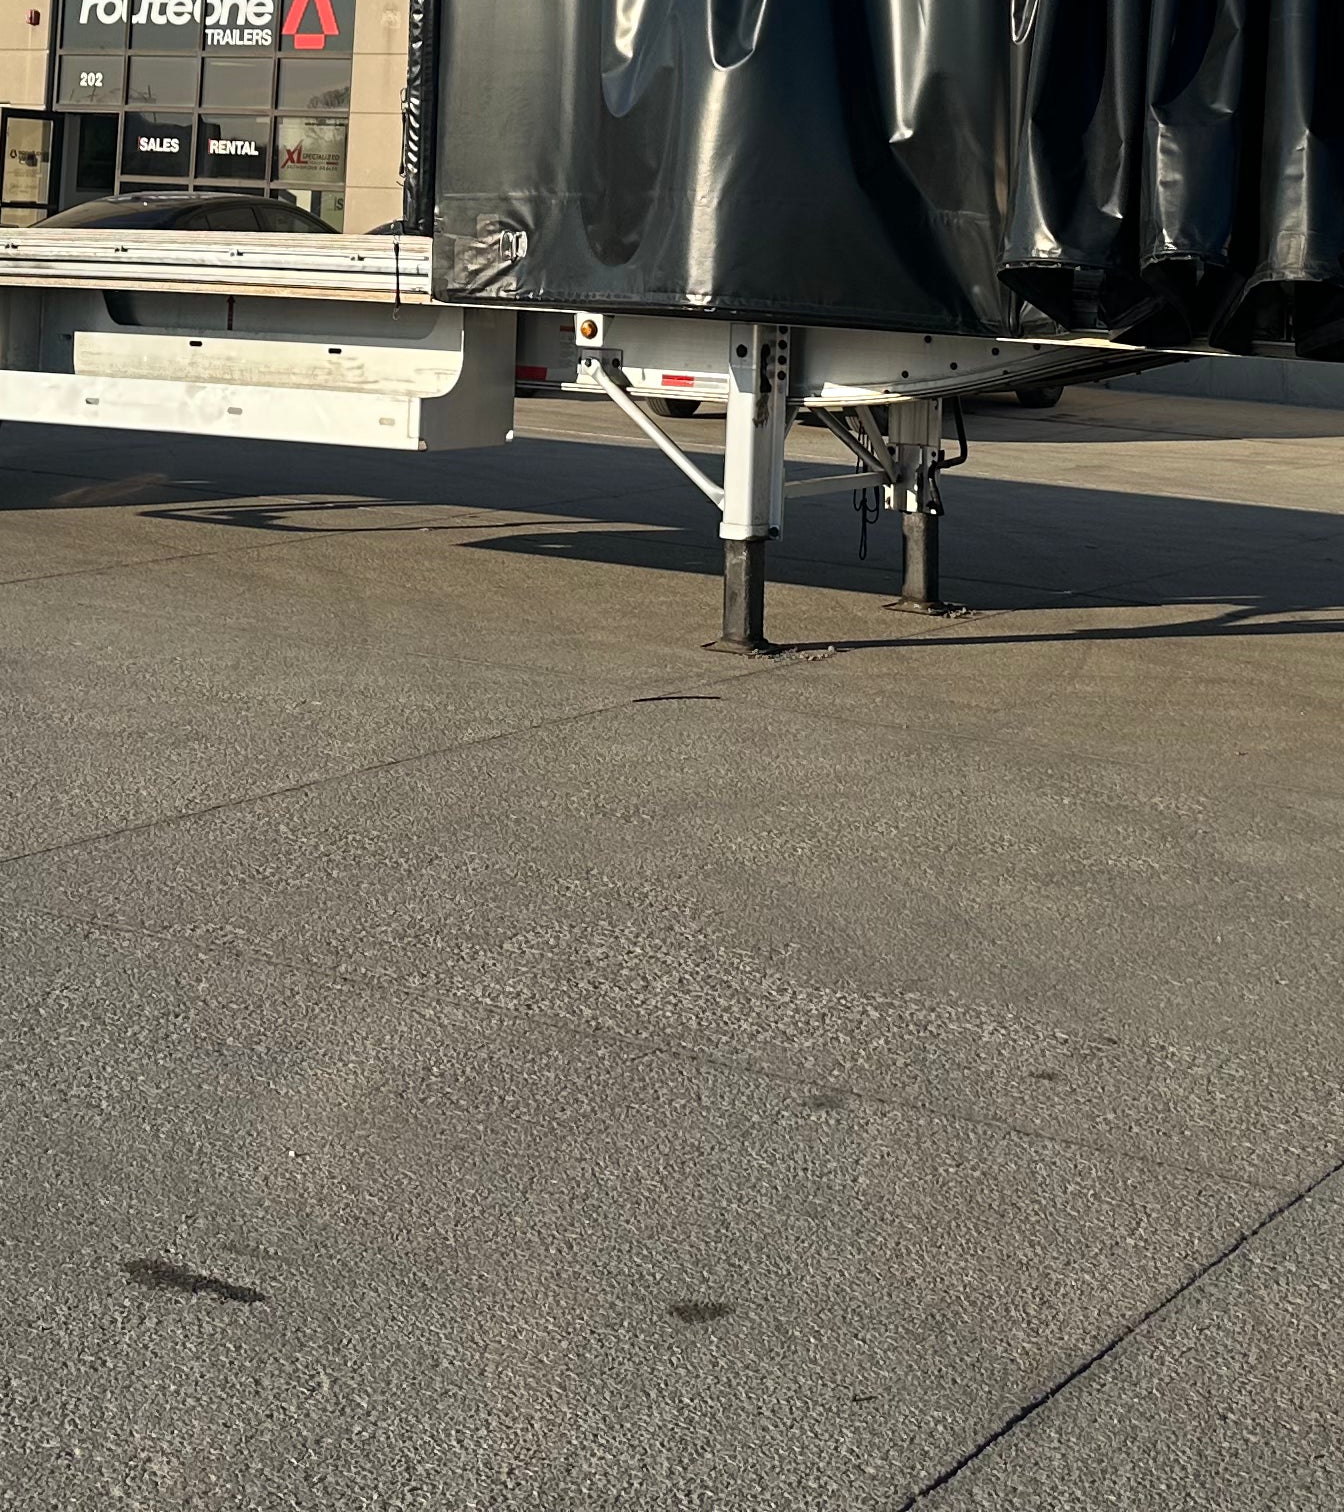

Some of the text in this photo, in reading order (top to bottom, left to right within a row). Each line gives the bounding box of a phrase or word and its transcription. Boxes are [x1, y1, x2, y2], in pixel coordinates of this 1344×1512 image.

[206, 29, 272, 46] TRAILERS
[80, 72, 103, 87] 202
[140, 138, 180, 153] SALES
[210, 139, 259, 156] RENTAL
[281, 139, 308, 168] XL
